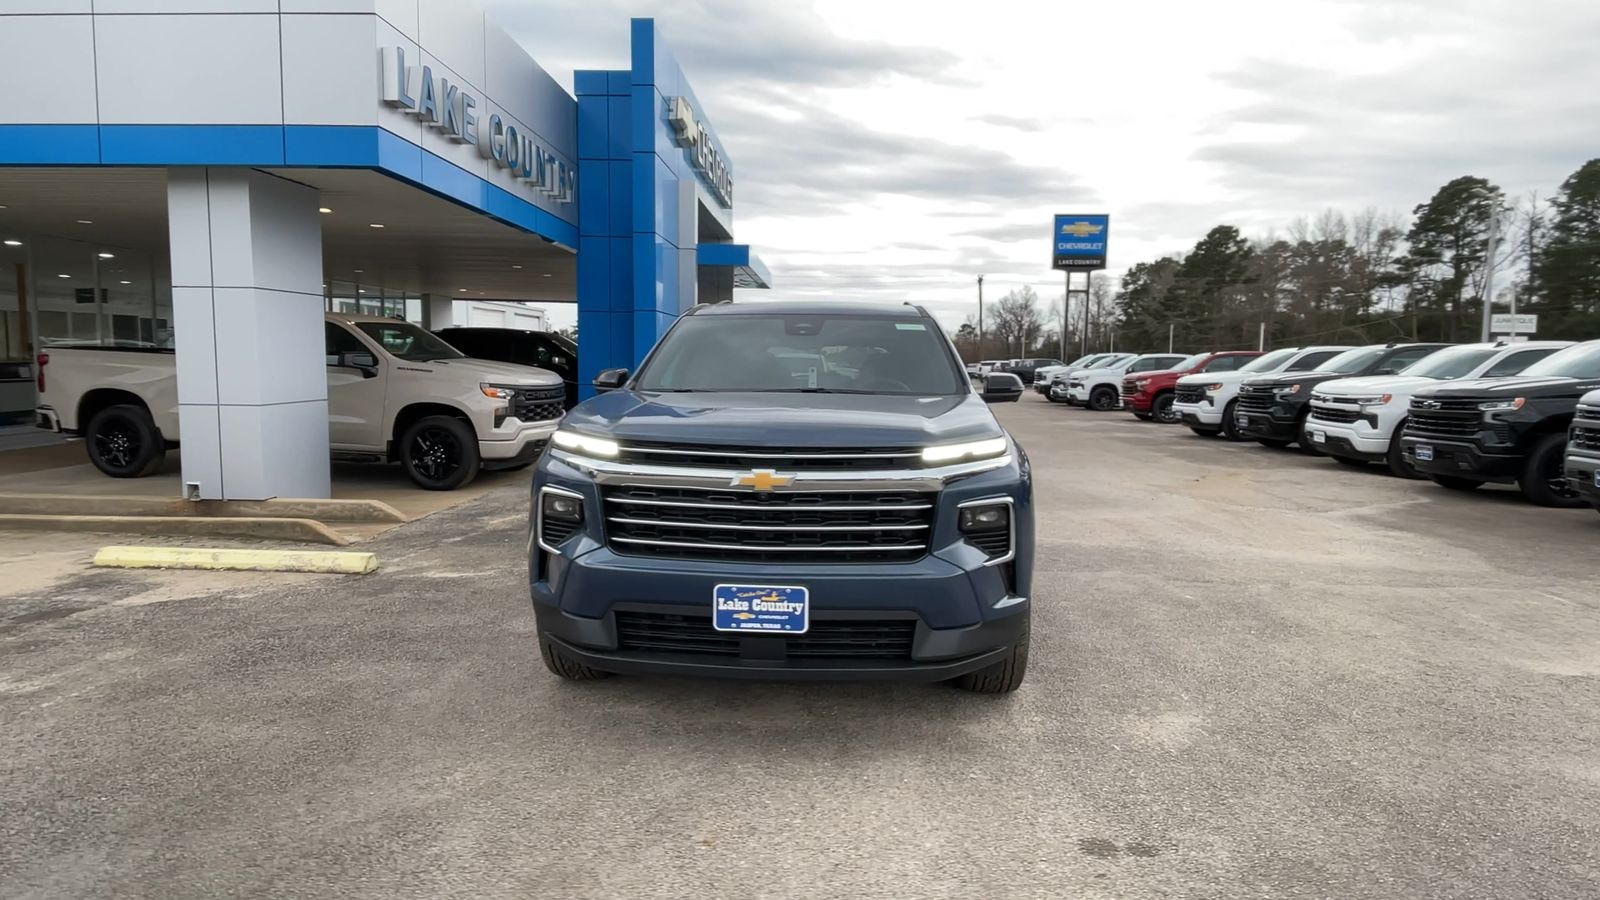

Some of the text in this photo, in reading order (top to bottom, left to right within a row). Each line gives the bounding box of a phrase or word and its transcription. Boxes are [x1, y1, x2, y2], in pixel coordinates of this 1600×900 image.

[385, 46, 576, 203] LAKE COUNTRY
[1058, 242, 1104, 250] CHEVROLET
[718, 598, 804, 615] Lake Country
